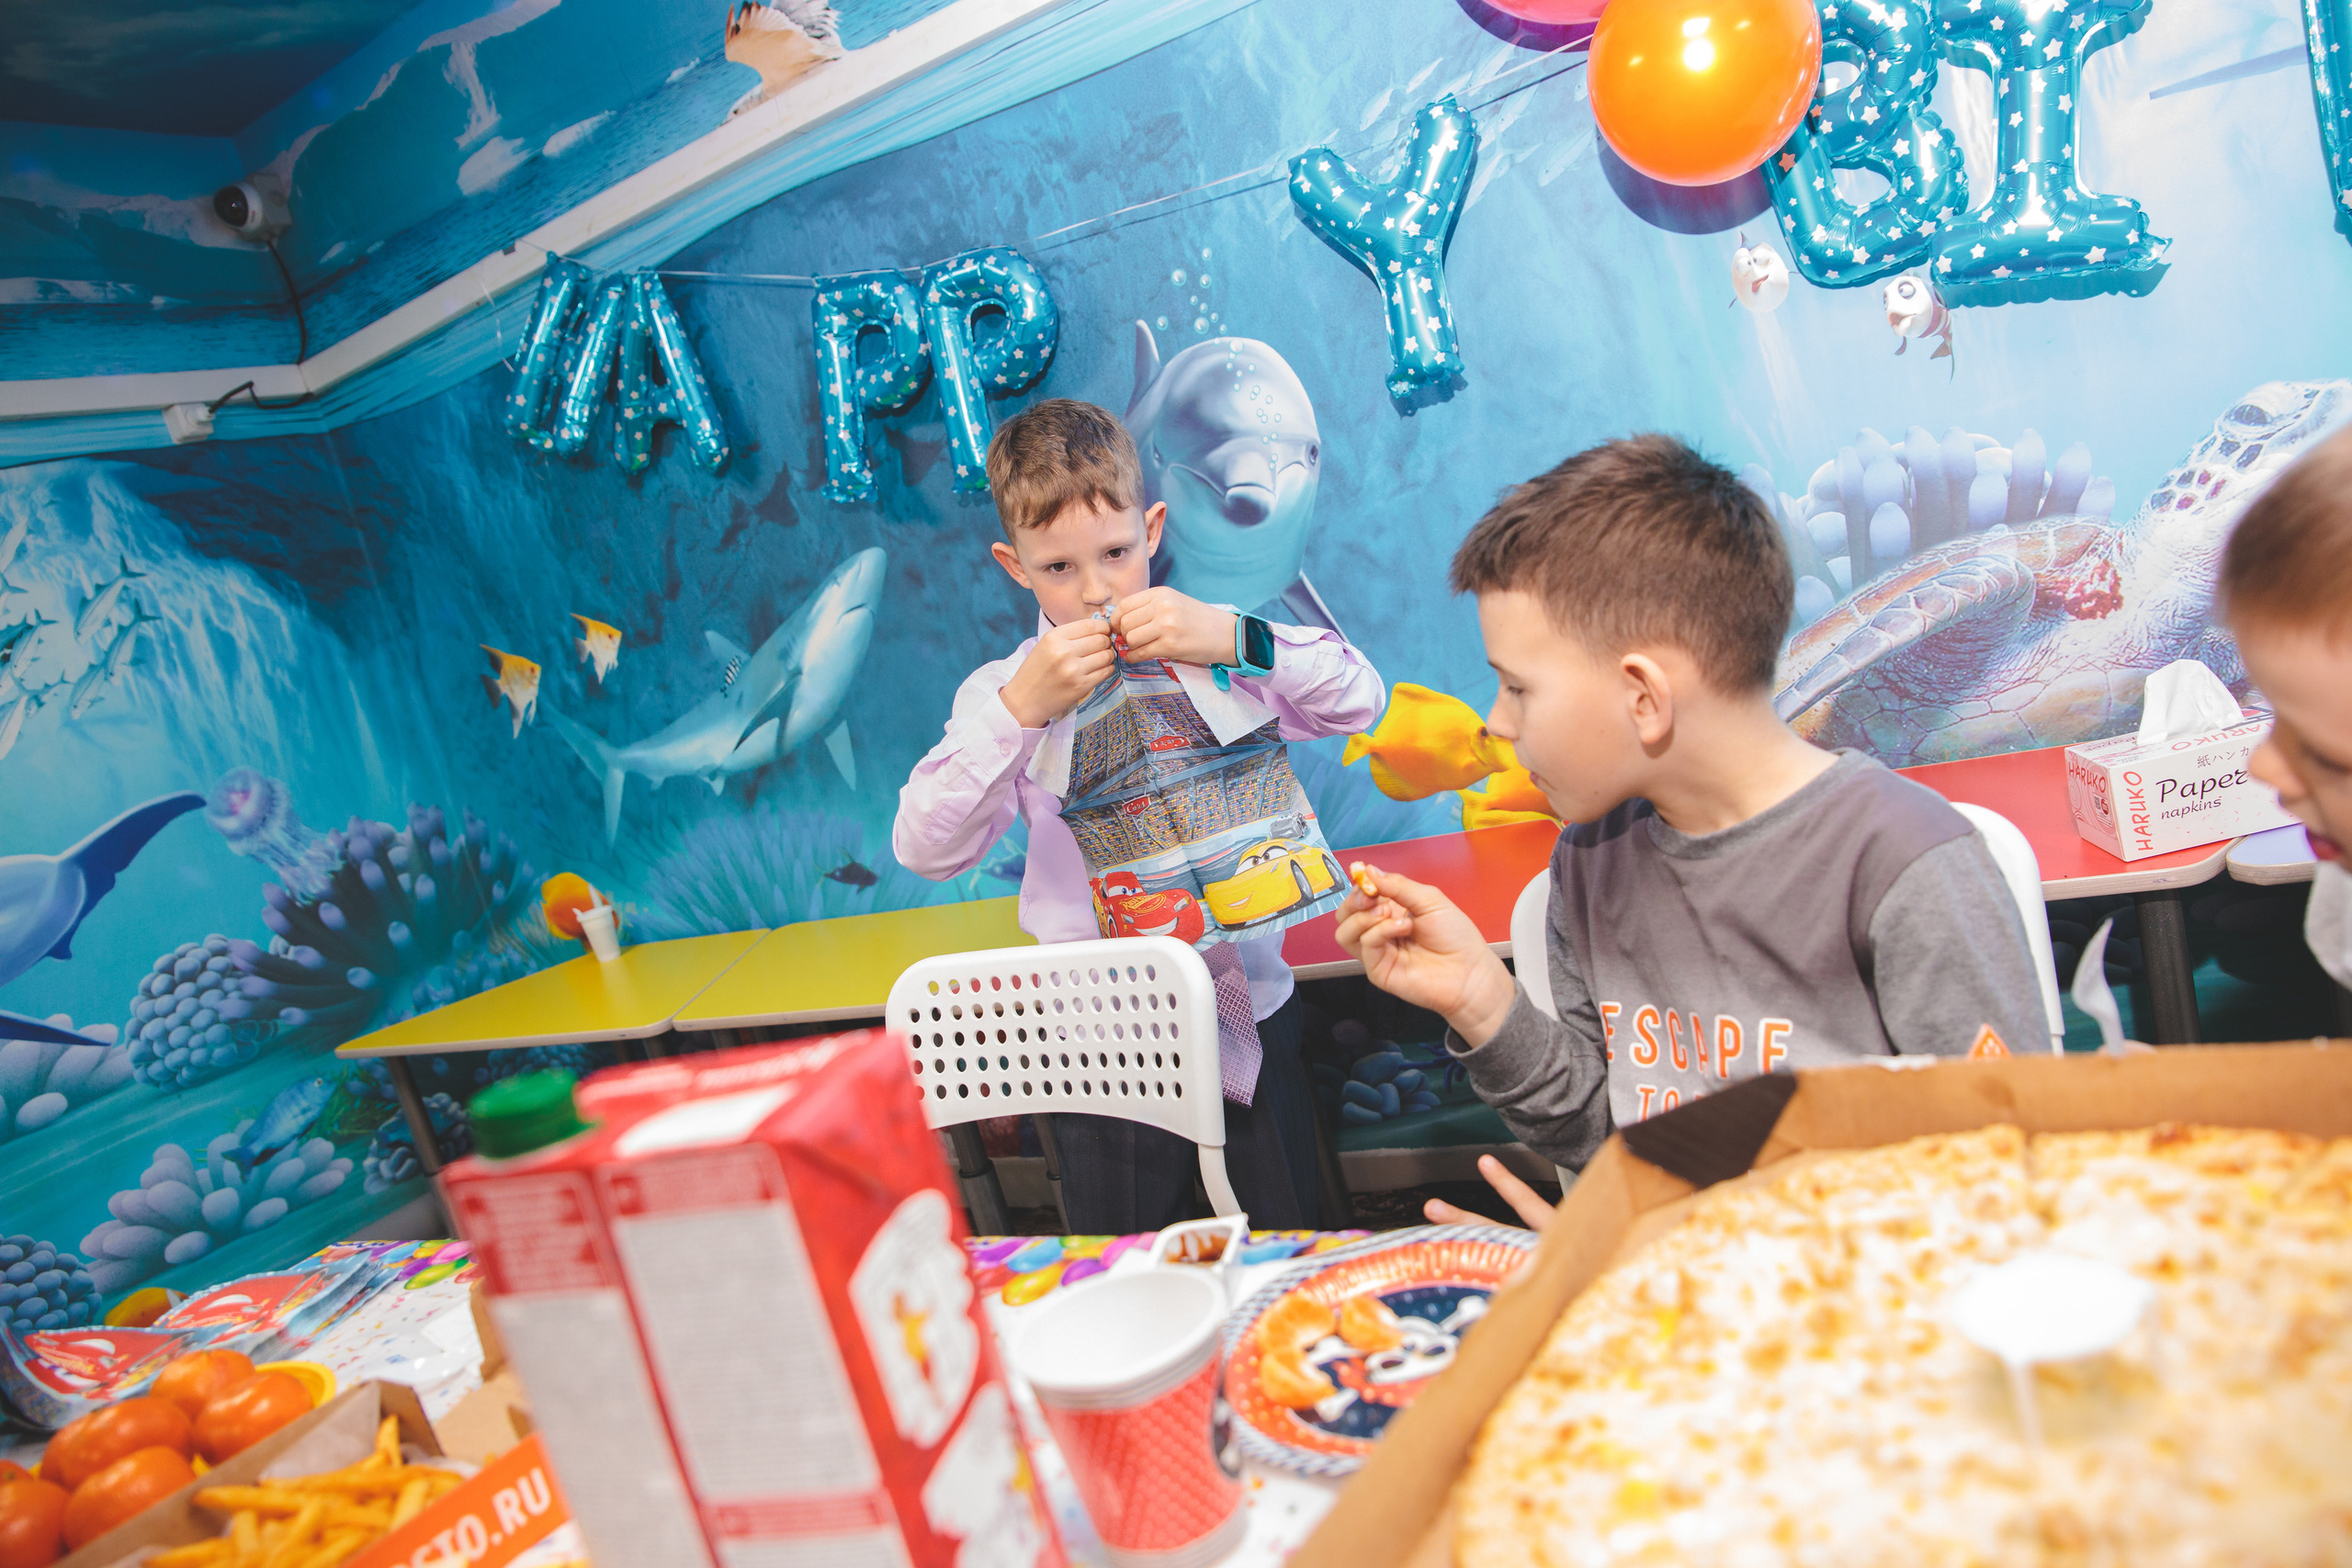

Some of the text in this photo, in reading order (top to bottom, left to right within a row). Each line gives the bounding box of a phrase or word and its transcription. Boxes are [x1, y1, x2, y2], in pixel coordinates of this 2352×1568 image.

[2067, 761, 2107, 794] HARUKO
[2155, 769, 2248, 804] Paper
[2122, 771, 2154, 851] HARUKO
[2161, 797, 2222, 819] napkins
